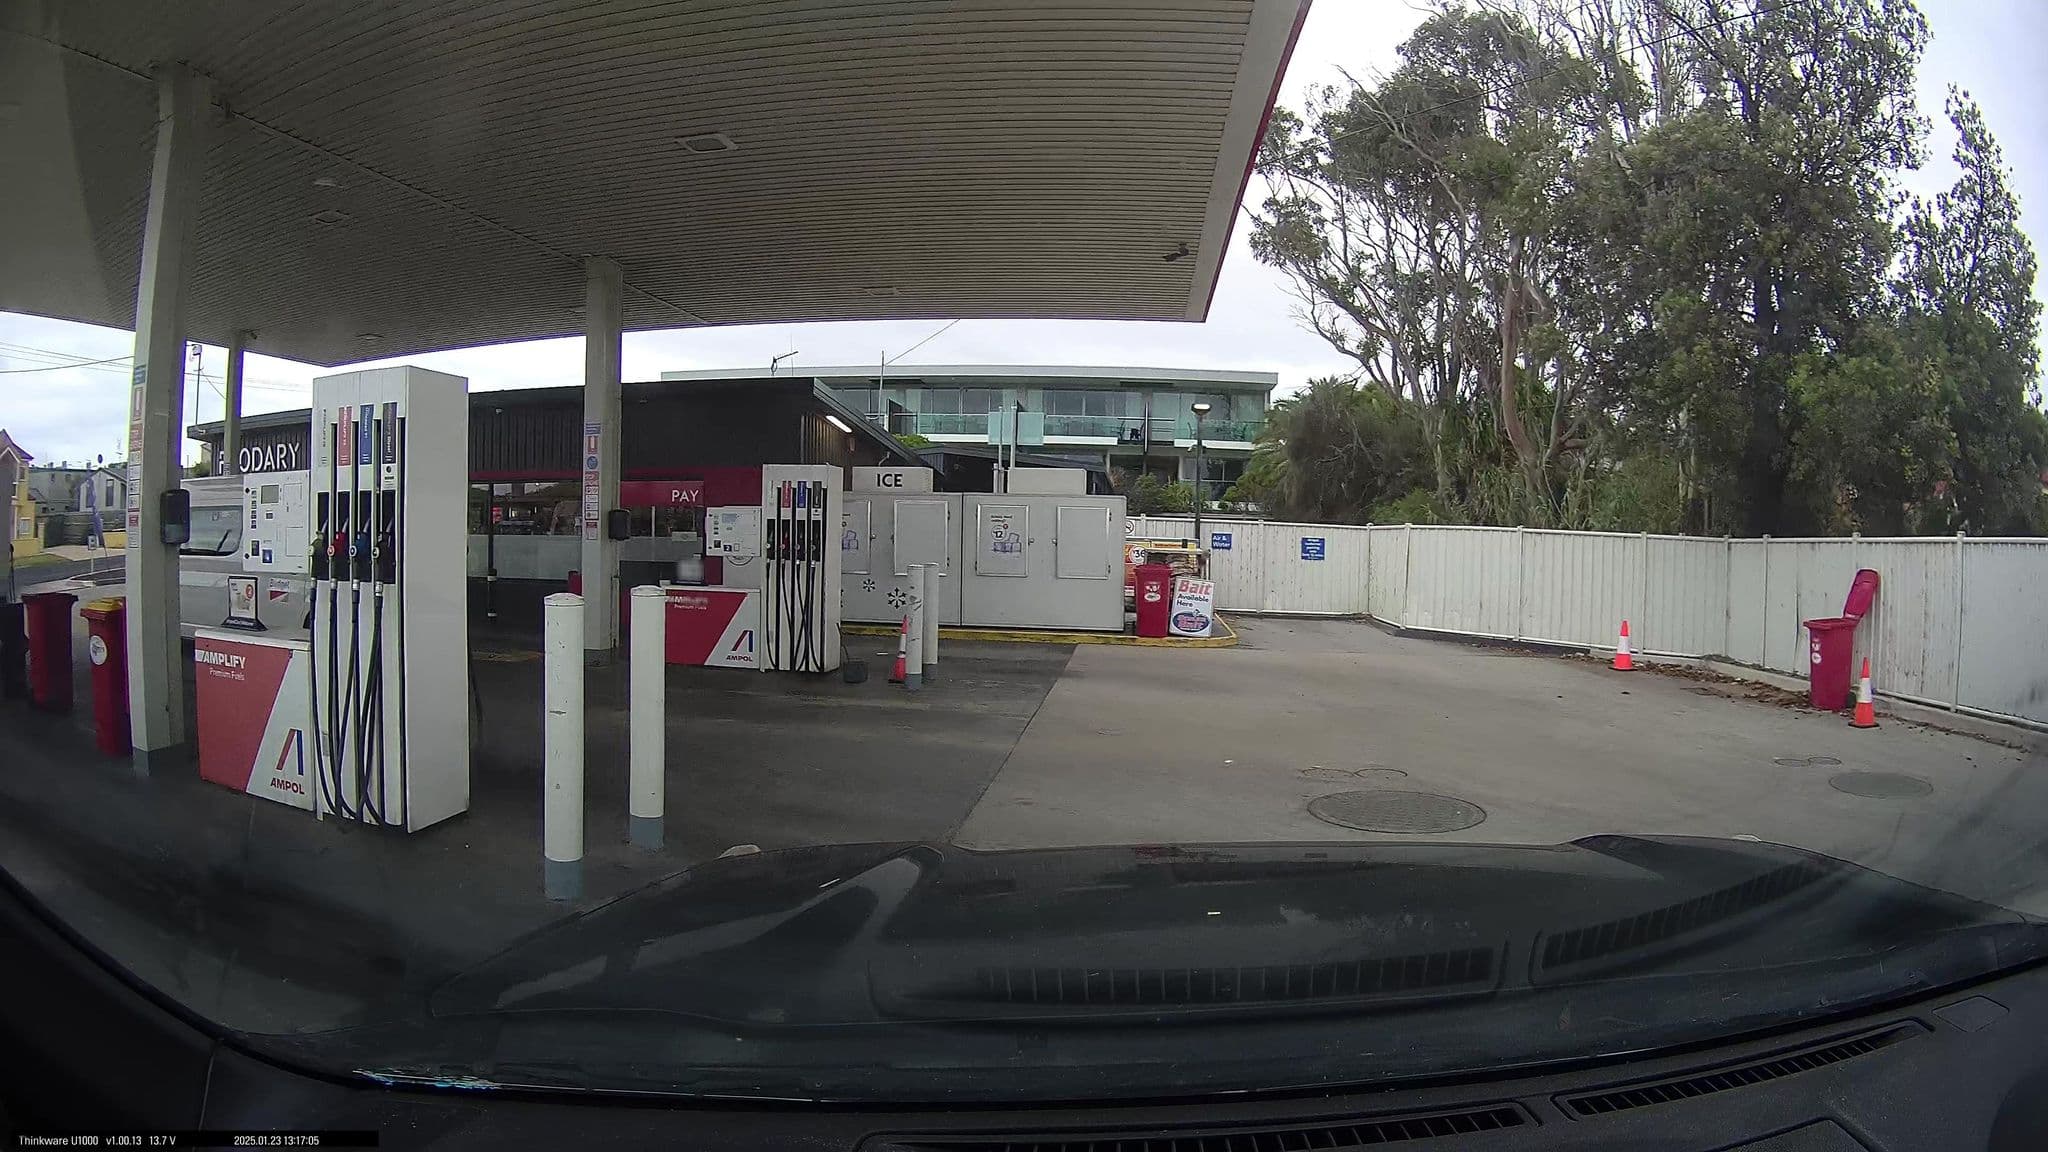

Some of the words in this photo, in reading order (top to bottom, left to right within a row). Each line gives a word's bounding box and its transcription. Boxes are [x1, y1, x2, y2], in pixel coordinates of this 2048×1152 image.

[877, 473, 903, 487] ICE
[671, 489, 699, 502] PAY
[1178, 579, 1212, 595] Bait
[1178, 593, 1209, 602] Available
[203, 651, 246, 669] AMPLIFY
[270, 777, 305, 795] AMPOL
